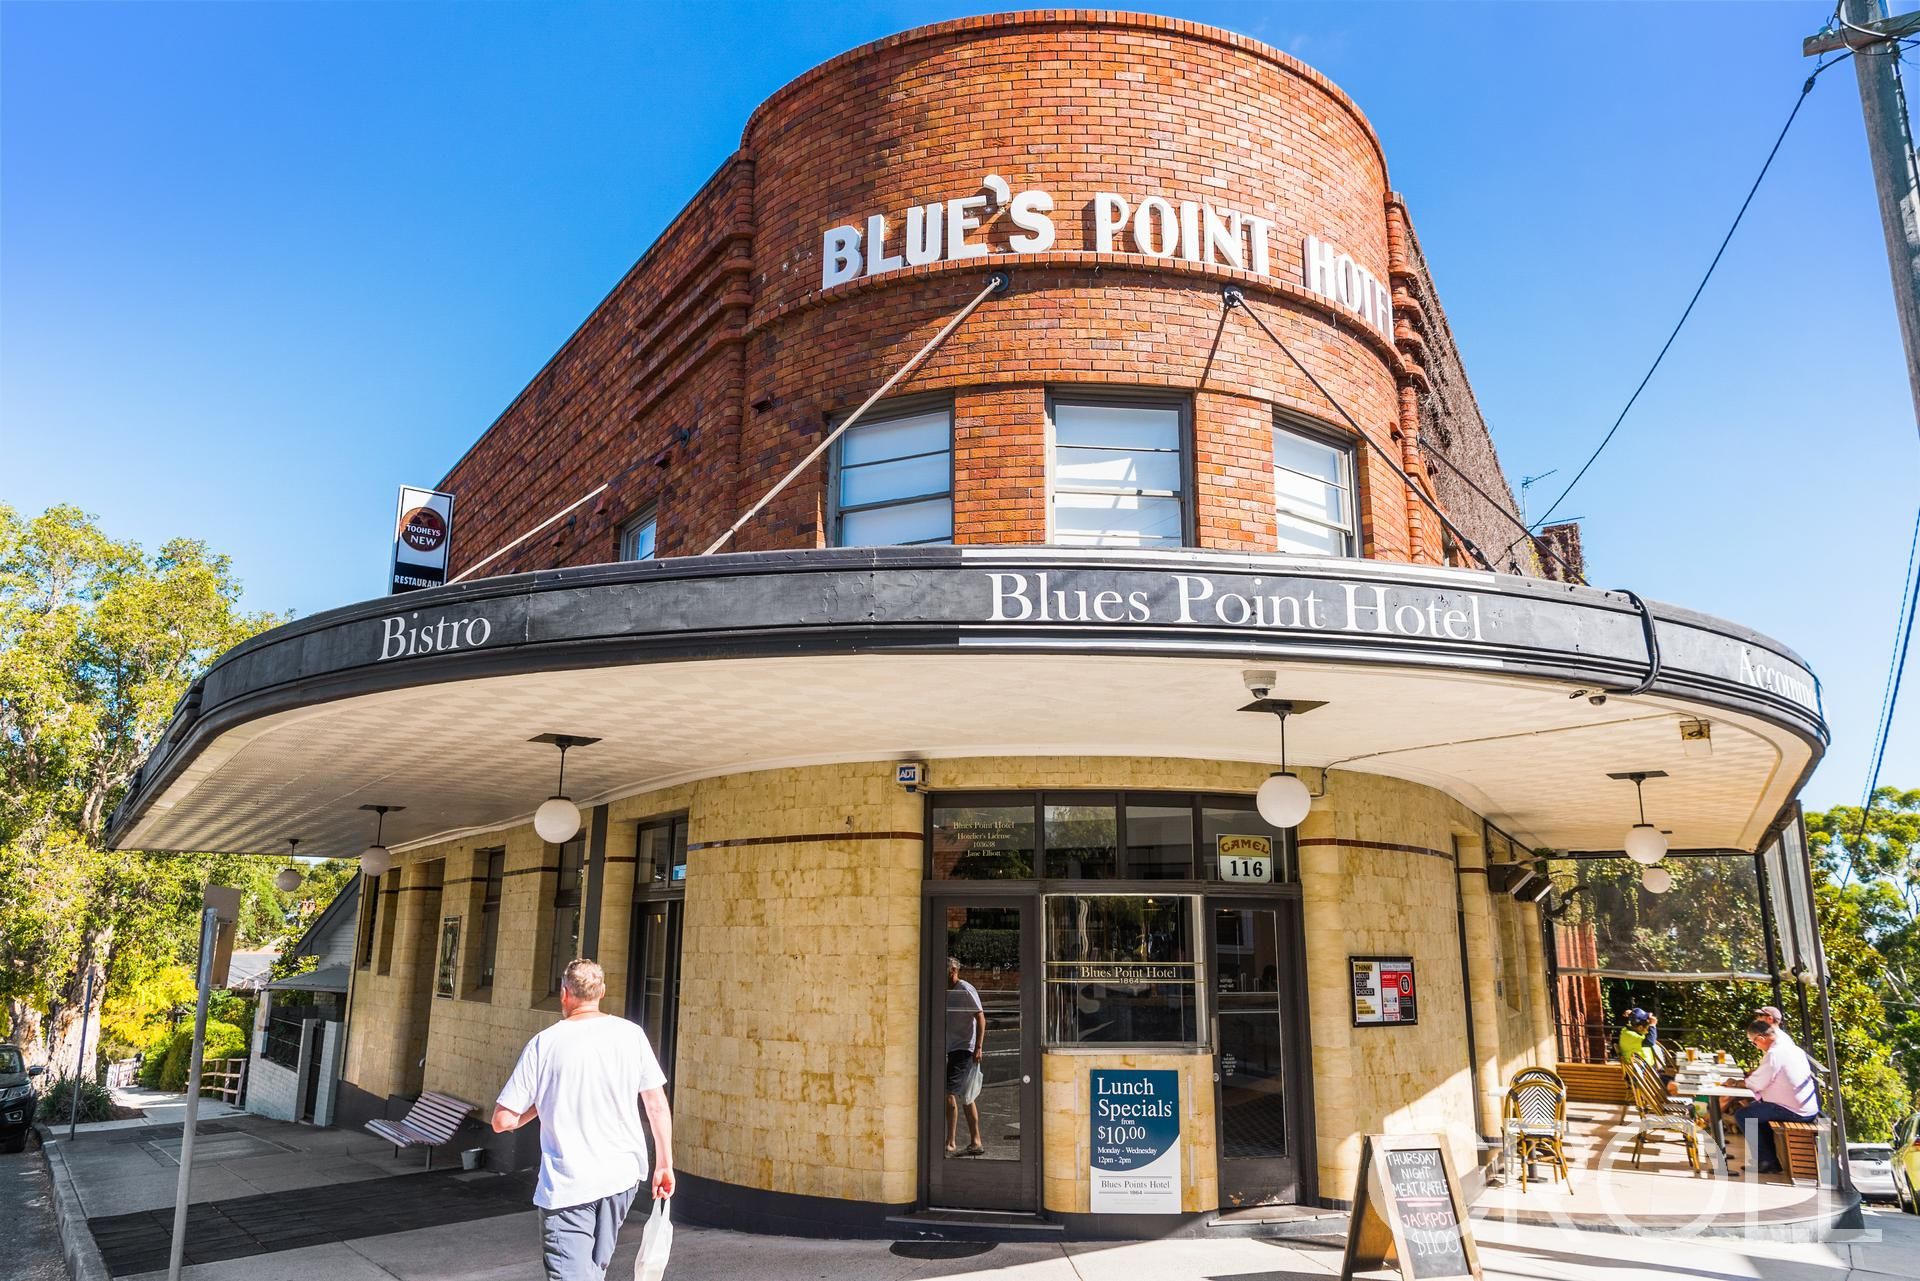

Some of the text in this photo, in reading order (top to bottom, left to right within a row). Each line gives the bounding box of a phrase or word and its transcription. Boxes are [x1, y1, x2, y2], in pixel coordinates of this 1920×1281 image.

[822, 174, 1055, 290] BLUE'S
[1095, 191, 1276, 277] POINT
[406, 524, 441, 537] TOOHEYS
[410, 535, 437, 547] NEW
[394, 575, 442, 588] RESTAURANT
[985, 572, 1486, 642] Blues Point Hotel
[377, 612, 492, 662] Bistro
[900, 769, 915, 779] ADT
[994, 821, 1015, 829] Hotel
[966, 849, 980, 858] Jane
[1221, 839, 1269, 854] CAMEL
[1230, 860, 1263, 877] 116
[1081, 966, 1177, 978] Blues Point Hotel
[1097, 1077, 1155, 1095] Lunch
[1097, 1126, 1146, 1144] $10.00
[1097, 1146, 1120, 1155] Monday
[1125, 1146, 1158, 1155] Wednesday
[1098, 1157, 1114, 1165] 12pm
[1118, 1157, 1132, 1165] 2pm
[1385, 1151, 1436, 1166] THURSDAY
[1401, 1166, 1431, 1179] NIGHT
[1101, 1180, 1170, 1189] Blues Points Hotel
[1393, 1179, 1449, 1198] MEAT RAFFLE
[1402, 1211, 1455, 1228] JACKPOT
[1412, 1229, 1459, 1256] $1100
